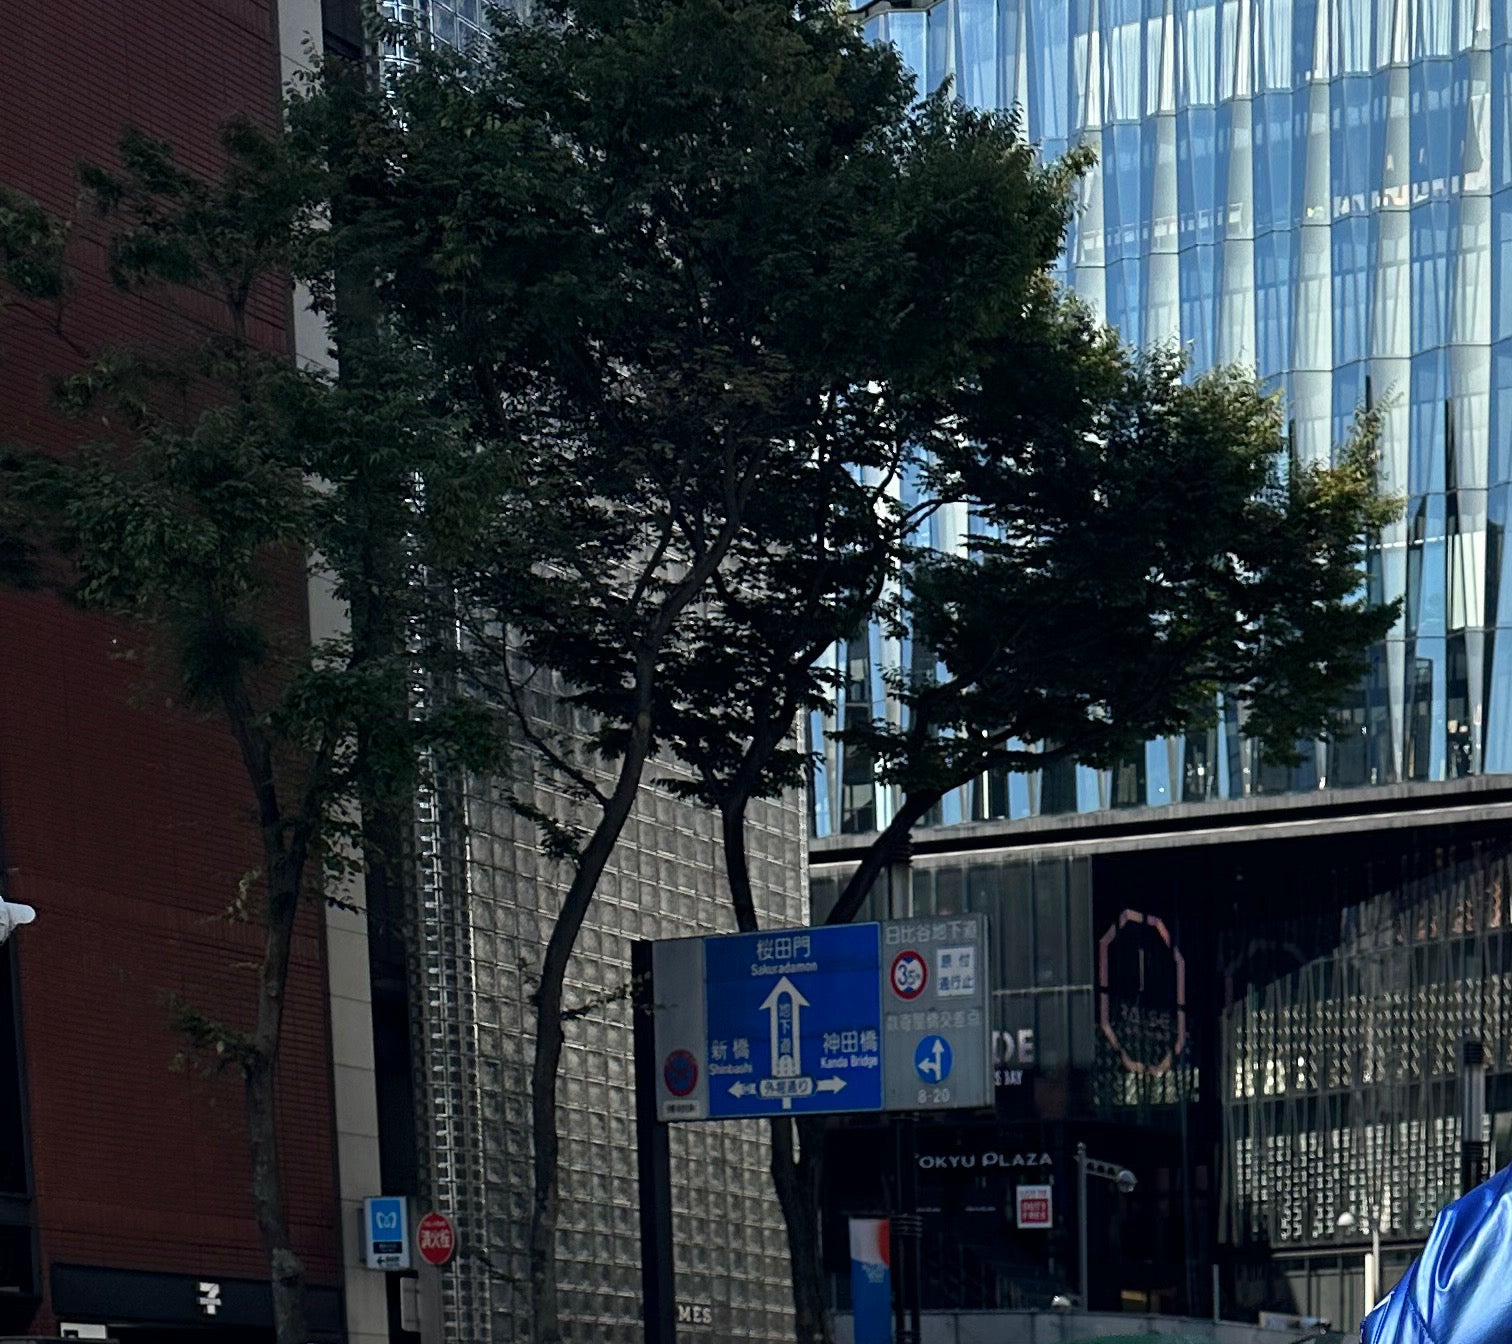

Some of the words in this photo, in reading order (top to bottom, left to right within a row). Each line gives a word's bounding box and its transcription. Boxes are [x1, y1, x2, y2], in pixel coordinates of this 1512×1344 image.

[886, 920, 977, 945] 日比谷地下道
[757, 935, 811, 961] 桜田門
[751, 961, 818, 976] Sakuradamon
[711, 1038, 750, 1060] 新橋
[823, 1030, 878, 1054] 神田橋
[917, 1089, 950, 1103] 8-20
[914, 1153, 975, 1168] OKYU
[982, 1152, 1053, 1167] PLAZA
[421, 1230, 450, 1249] 消火栓
[678, 1304, 712, 1324] MES
